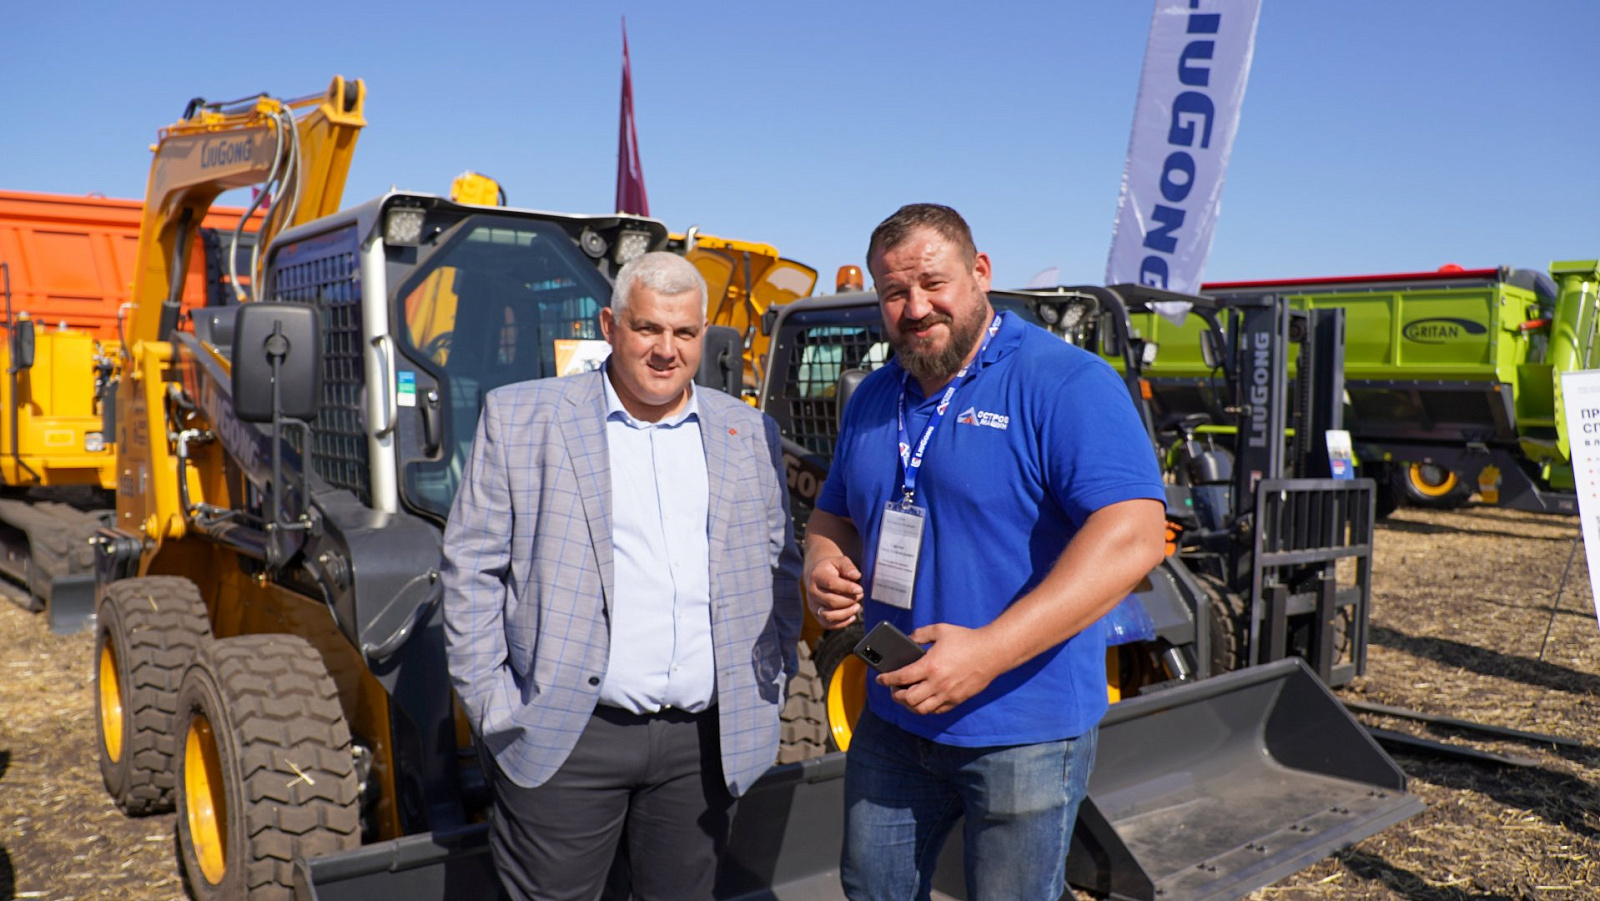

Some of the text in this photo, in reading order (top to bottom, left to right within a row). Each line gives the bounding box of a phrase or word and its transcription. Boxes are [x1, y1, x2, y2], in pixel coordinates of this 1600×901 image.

[1139, 0, 1221, 290] IUGONG
[1249, 332, 1270, 447] LIUGONG
[1409, 325, 1458, 339] GRITAN
